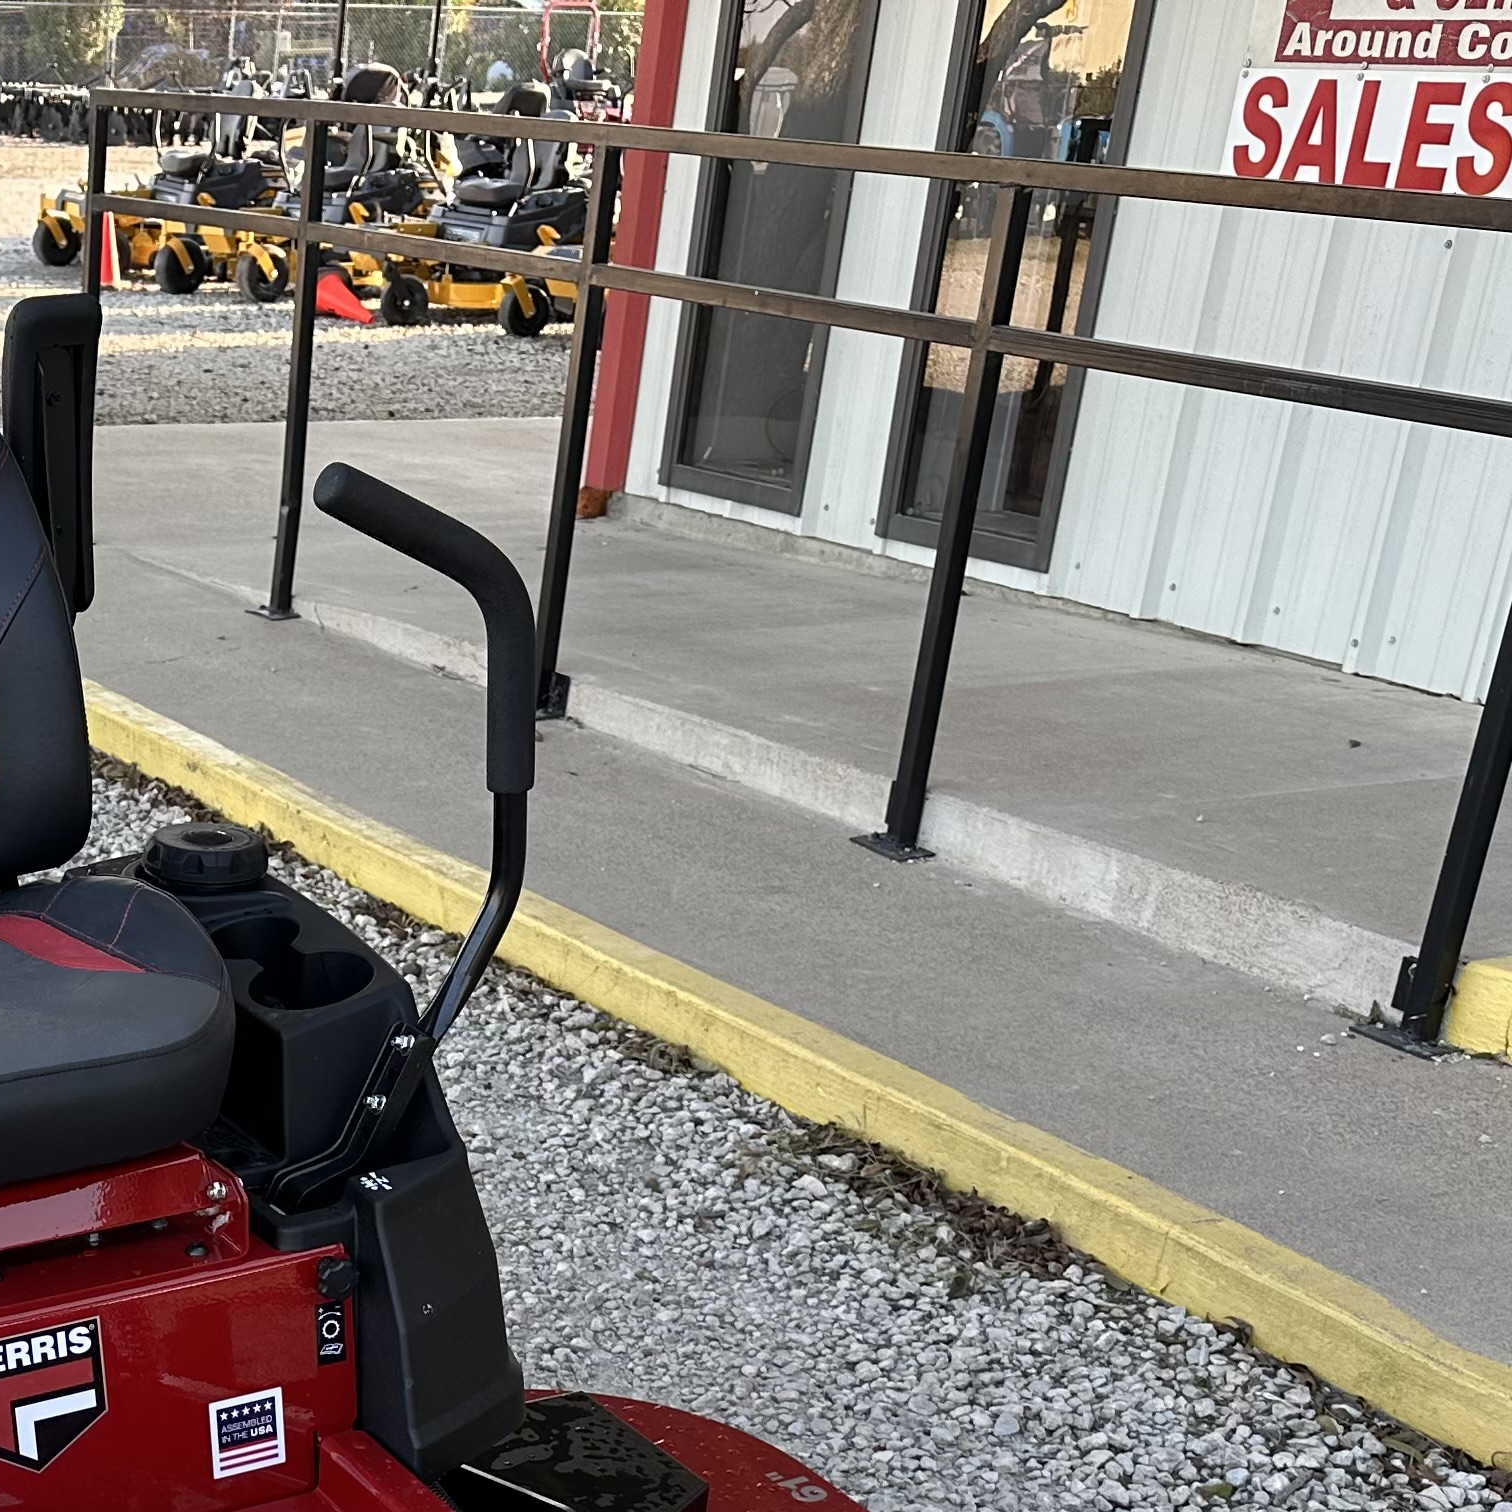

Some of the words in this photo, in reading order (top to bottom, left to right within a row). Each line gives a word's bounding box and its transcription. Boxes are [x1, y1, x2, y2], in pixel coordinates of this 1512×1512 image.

[1282, 21, 1444, 59] Around
[1456, 22, 1512, 61] Co
[1233, 76, 1512, 196] SALES
[221, 1414, 273, 1434] ASSEMBLED
[221, 1434, 231, 1444] IN
[232, 1430, 249, 1441] THE
[250, 1424, 274, 1437] USA
